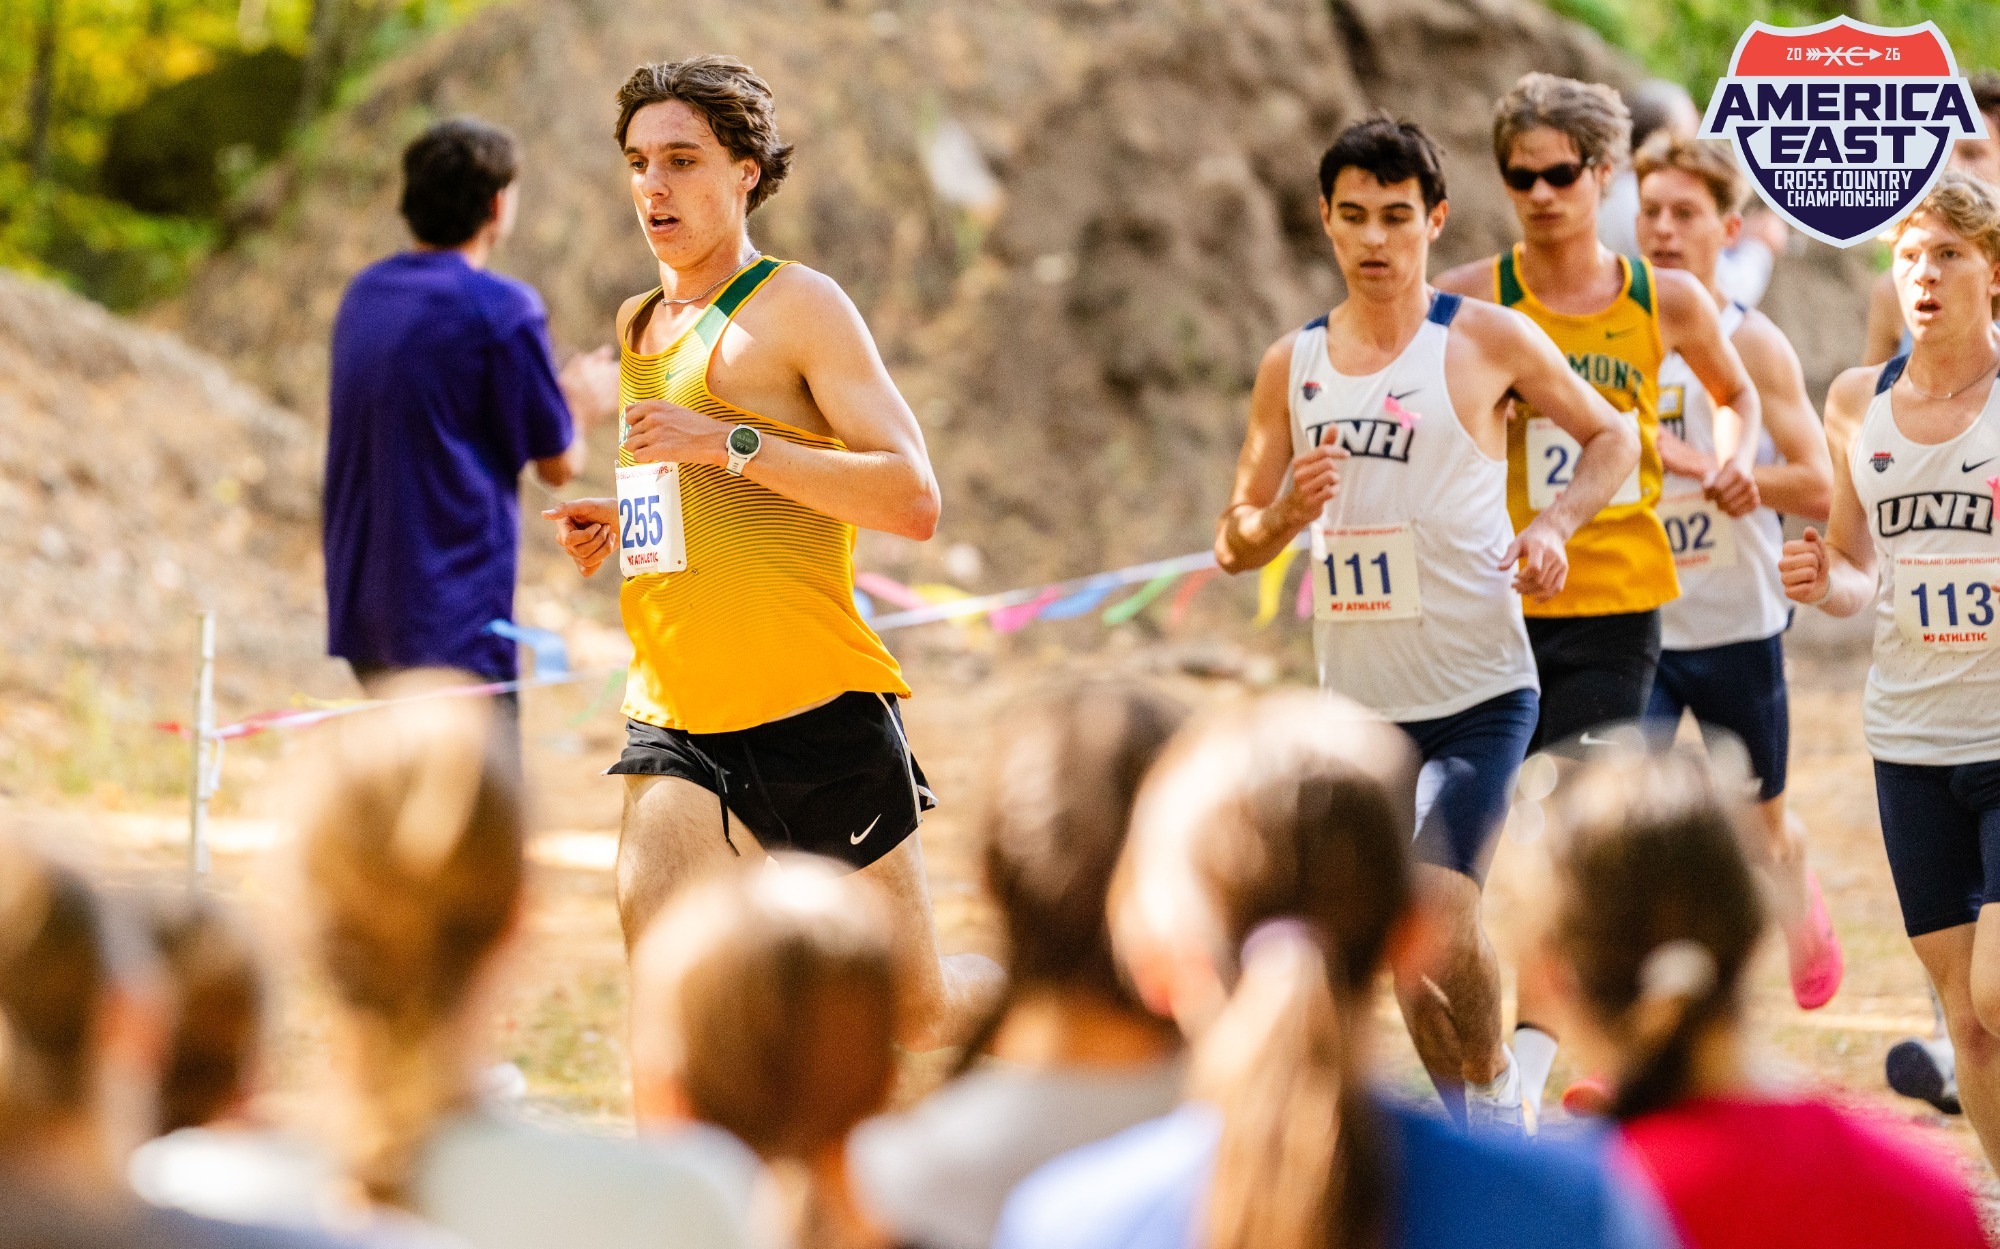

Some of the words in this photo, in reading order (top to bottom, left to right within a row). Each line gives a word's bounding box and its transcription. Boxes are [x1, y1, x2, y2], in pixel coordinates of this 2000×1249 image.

[620, 495, 663, 549] 255
[1878, 491, 1994, 537] UNH
[1324, 552, 1391, 595] 111
[1900, 558, 1912, 566] NEW
[1914, 558, 1943, 566] ENGLAND
[1346, 600, 1391, 611] ATHLETIC
[1911, 582, 1994, 627] 113
[1938, 632, 1987, 642] ATHLETIC
